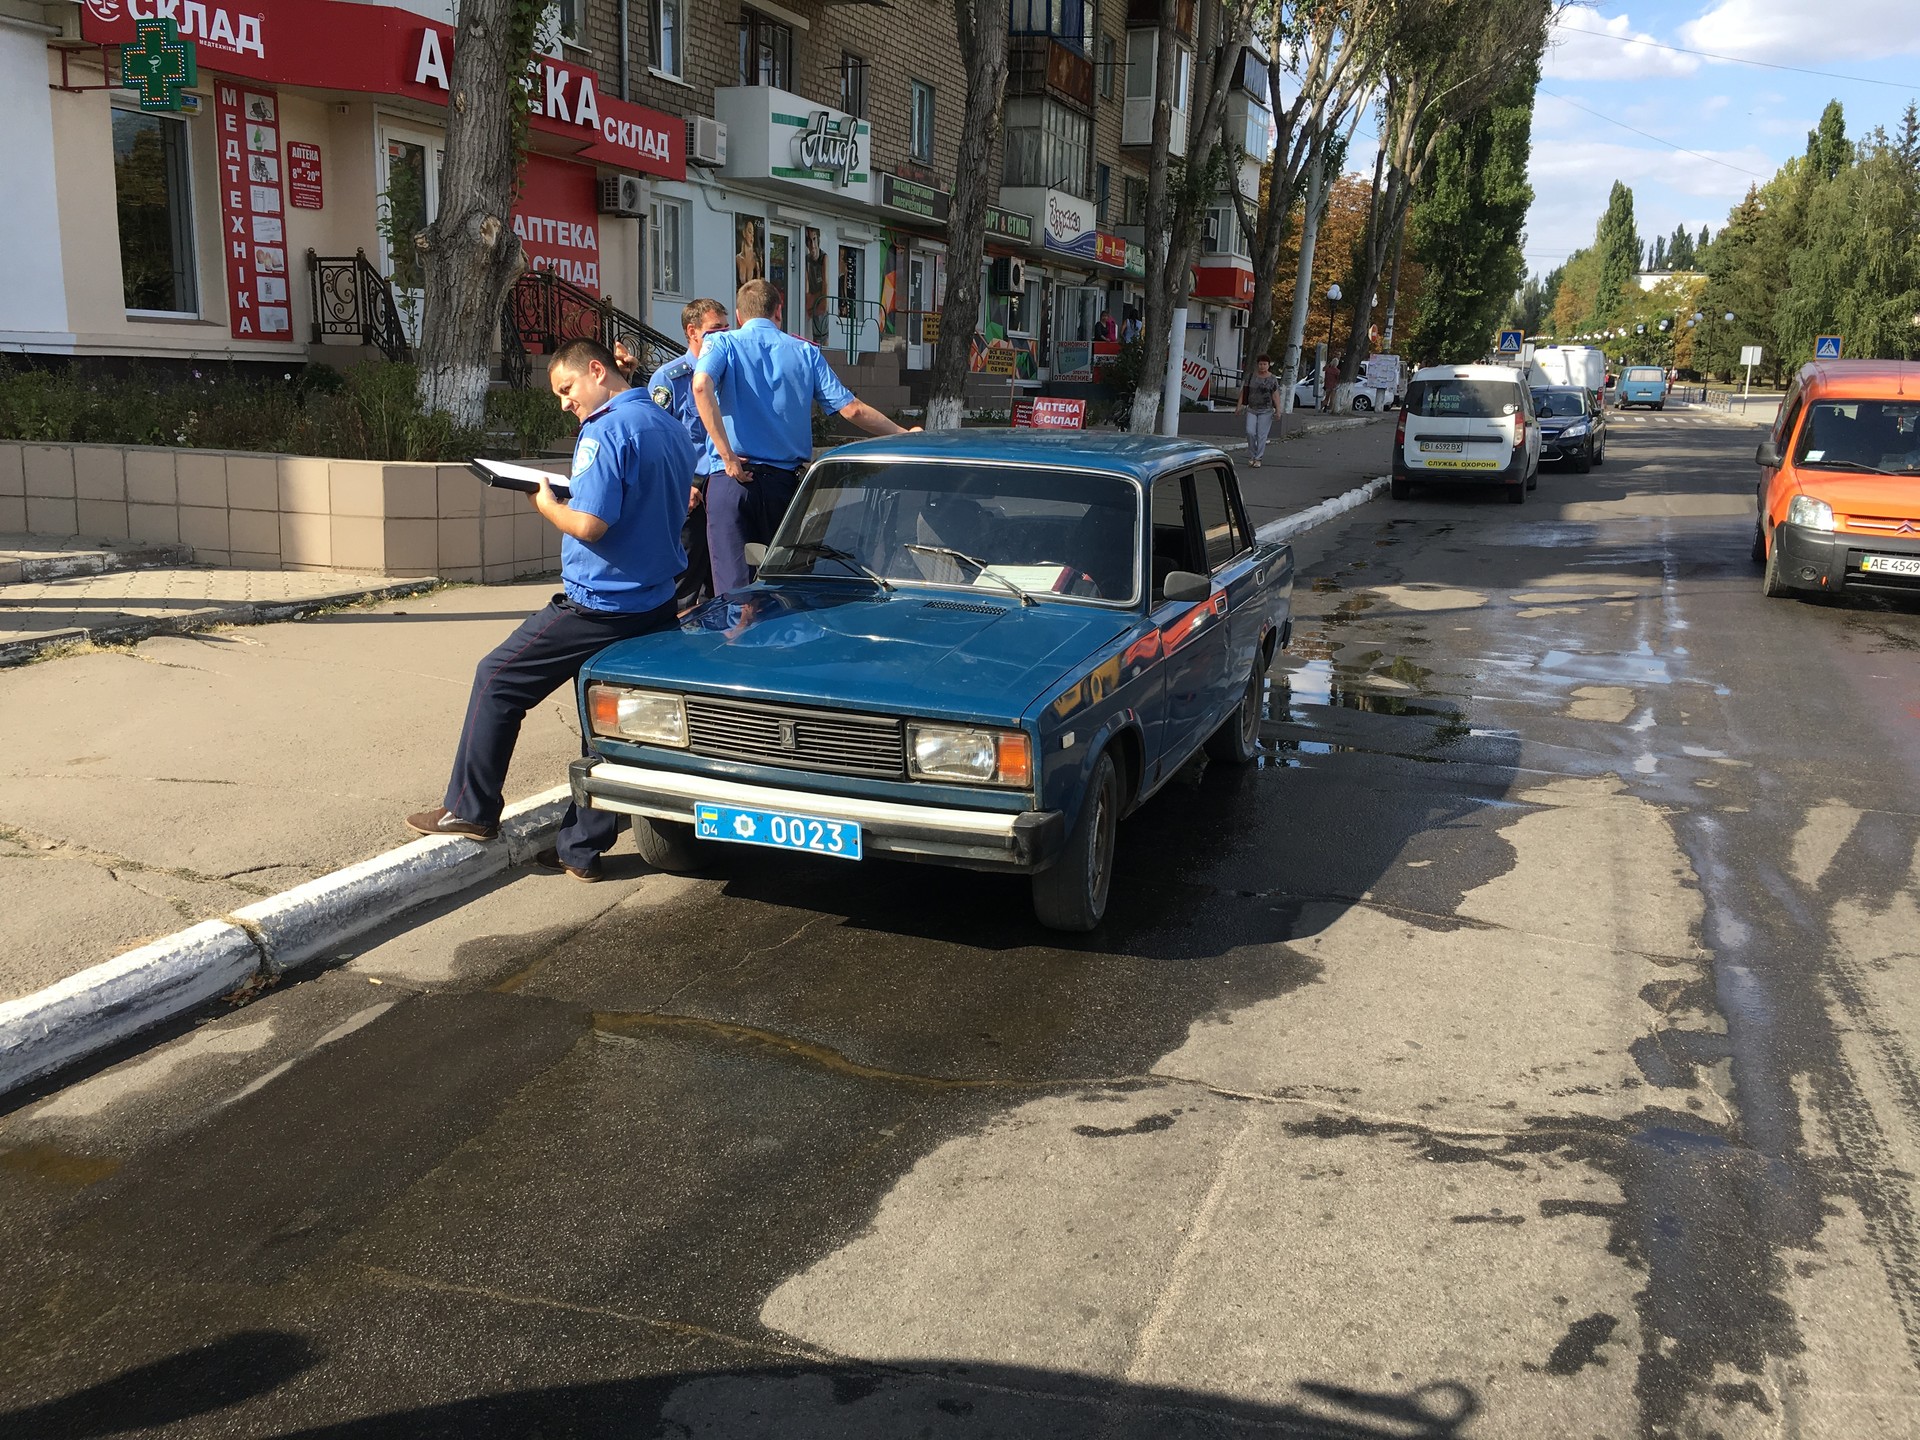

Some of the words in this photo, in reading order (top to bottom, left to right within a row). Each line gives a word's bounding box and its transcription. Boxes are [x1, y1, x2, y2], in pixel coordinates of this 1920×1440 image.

[603, 116, 670, 163] СКЛАД
[292, 146, 319, 162] АПТЕКА
[222, 87, 252, 333] МЕДТЕХНІКА
[513, 214, 597, 250] АПТЕКА
[1007, 215, 1030, 238] СТИЛЬ
[533, 255, 599, 289] СКЛАД
[1035, 401, 1080, 413] АПТЕКА
[1043, 415, 1079, 427] СКЛАД
[1427, 460, 1458, 468] СЛУЖБА
[1870, 558, 1889, 571] AE
[1891, 560, 1920, 573] 4549
[702, 822, 718, 836] 04
[770, 816, 844, 852] 0023
